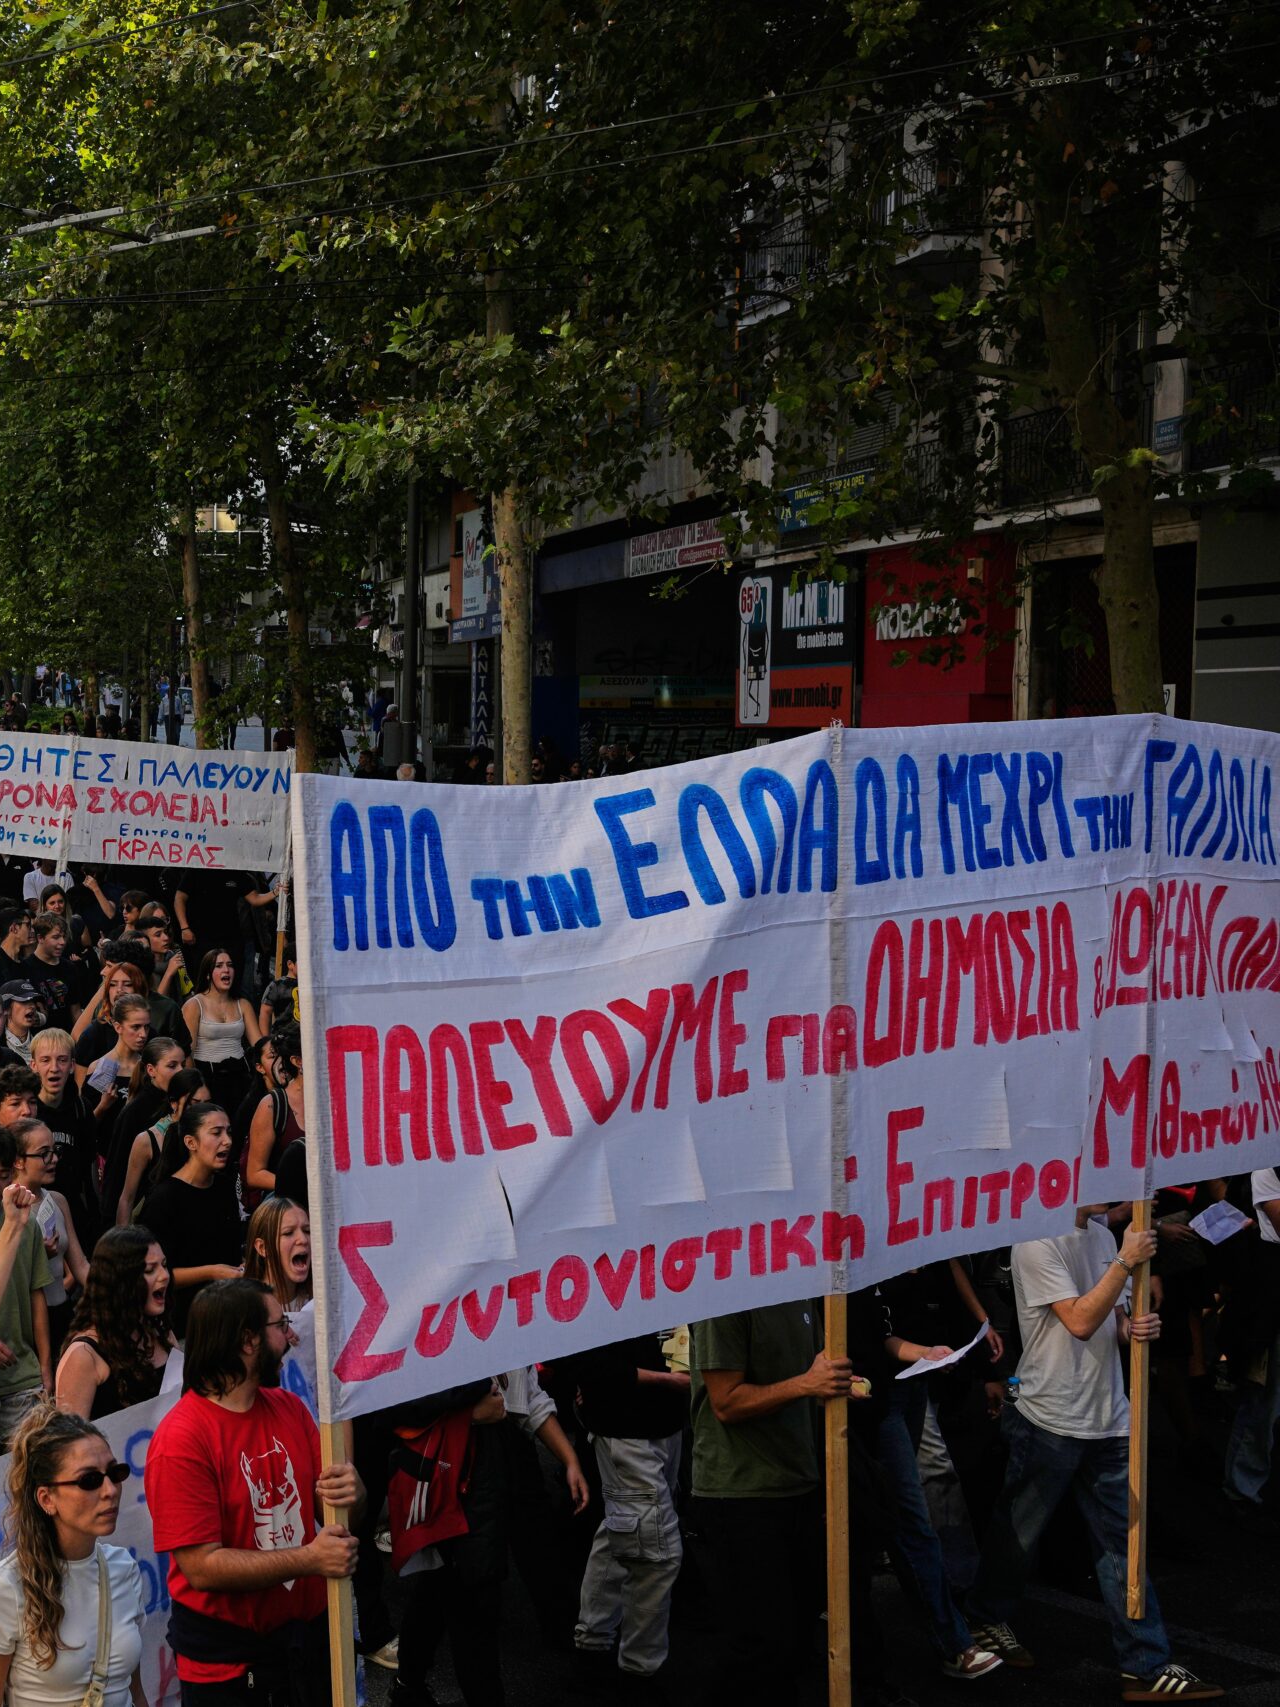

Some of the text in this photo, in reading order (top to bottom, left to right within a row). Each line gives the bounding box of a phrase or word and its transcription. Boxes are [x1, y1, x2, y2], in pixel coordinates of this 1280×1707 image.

[796, 630, 844, 649] the mobile store
[771, 683, 842, 709] www.mrmobi.gr
[138, 758, 291, 794] ΠΑΛΕΥΟΥΝ
[86, 785, 229, 828] ΣΧΟΛΕΙΑ!
[102, 838, 226, 868] ΓΚΡΑΒΑΣ
[330, 801, 457, 952] ΑΠΟ
[470, 867, 602, 940] ΤΗΝ
[937, 750, 1075, 875] ΜΕΧΡΙ
[1074, 791, 1134, 852] ΤΗΝ
[1144, 739, 1277, 866] ΓΑΛΛΙΑ
[325, 968, 749, 1174] ΠΑΛΕΥΟΥΜΕ
[765, 1004, 858, 1083] ΓΙΑ
[863, 901, 1081, 1068] ΔΗΜΟΣΙΑ
[1093, 1054, 1259, 1169] Μθητών
